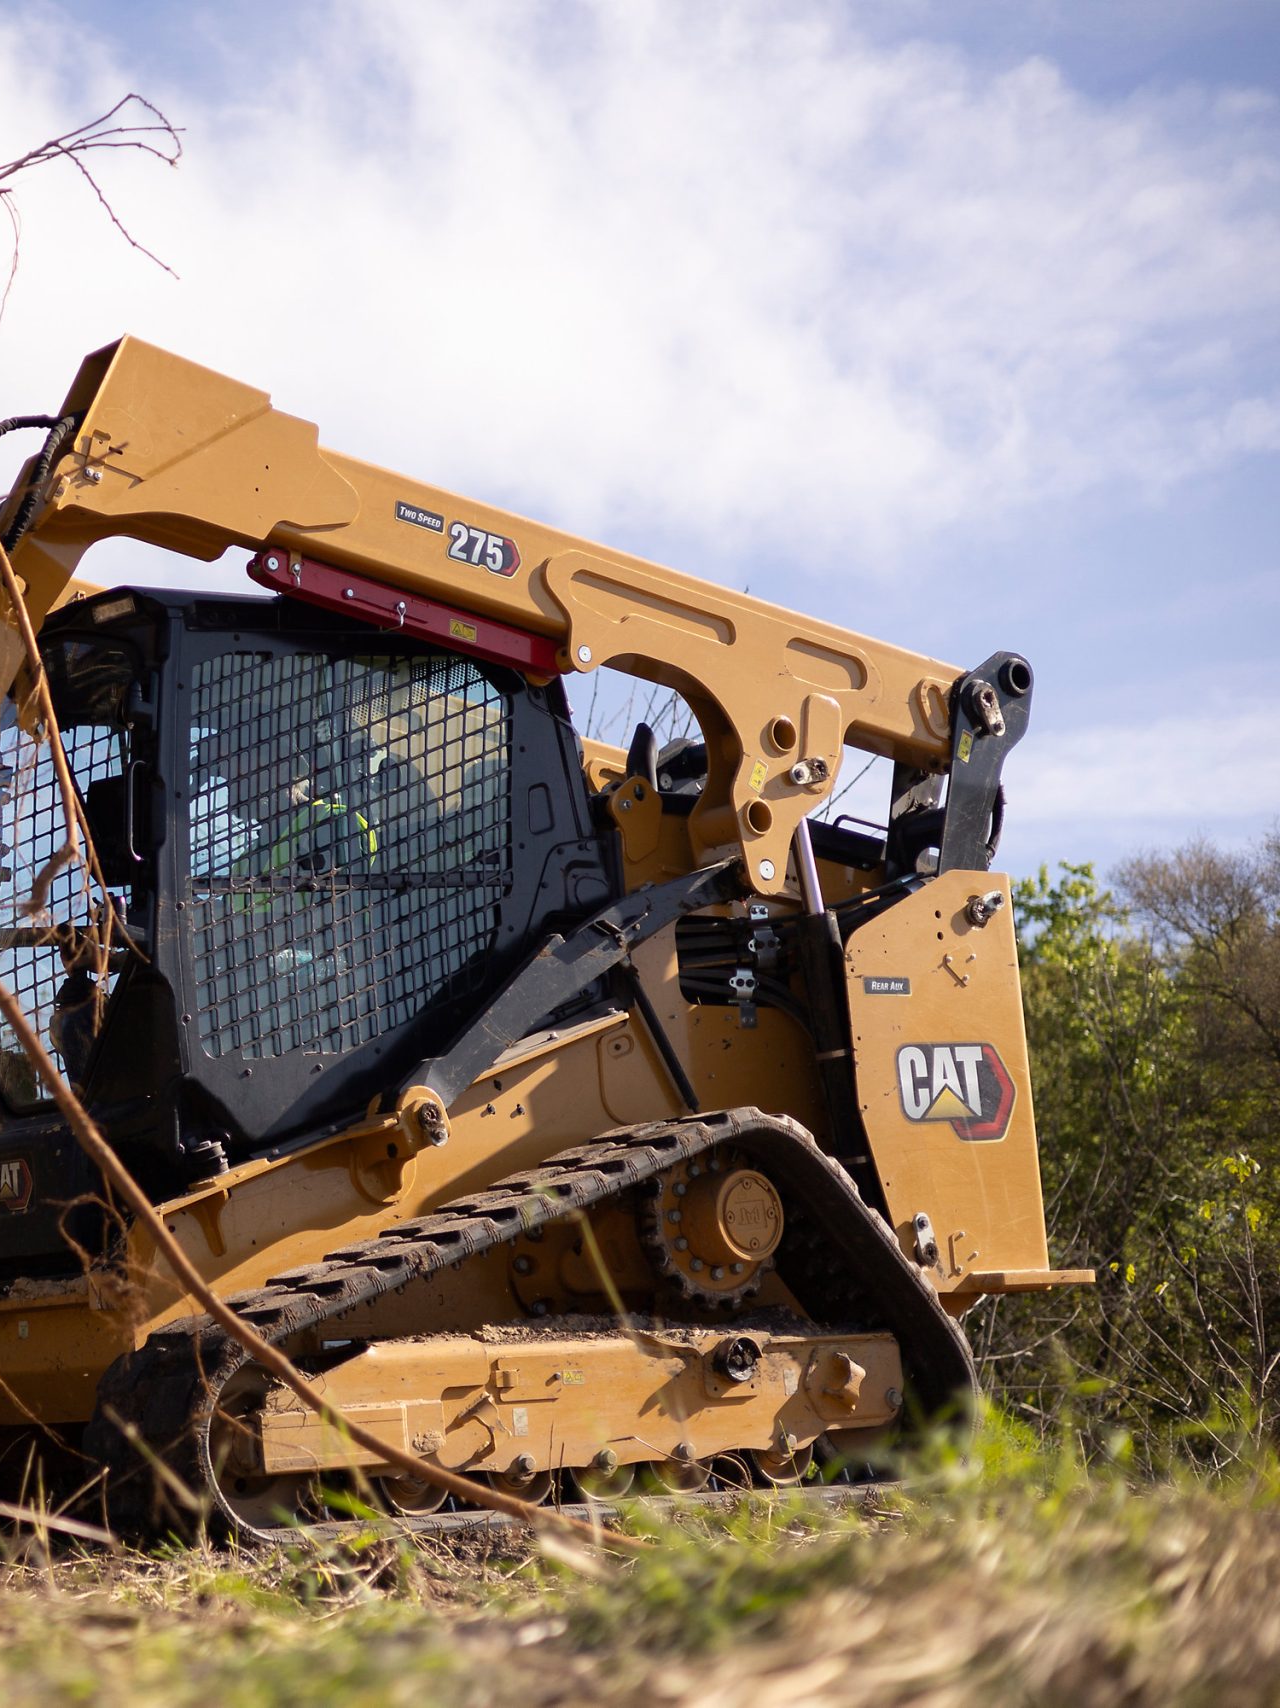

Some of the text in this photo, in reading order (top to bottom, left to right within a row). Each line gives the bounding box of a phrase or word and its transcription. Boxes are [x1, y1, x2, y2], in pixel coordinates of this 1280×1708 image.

[400, 506, 442, 528] TWO SPEED
[450, 523, 504, 571] 275
[871, 981, 904, 990] REAR AUX
[898, 1046, 983, 1119] CAT
